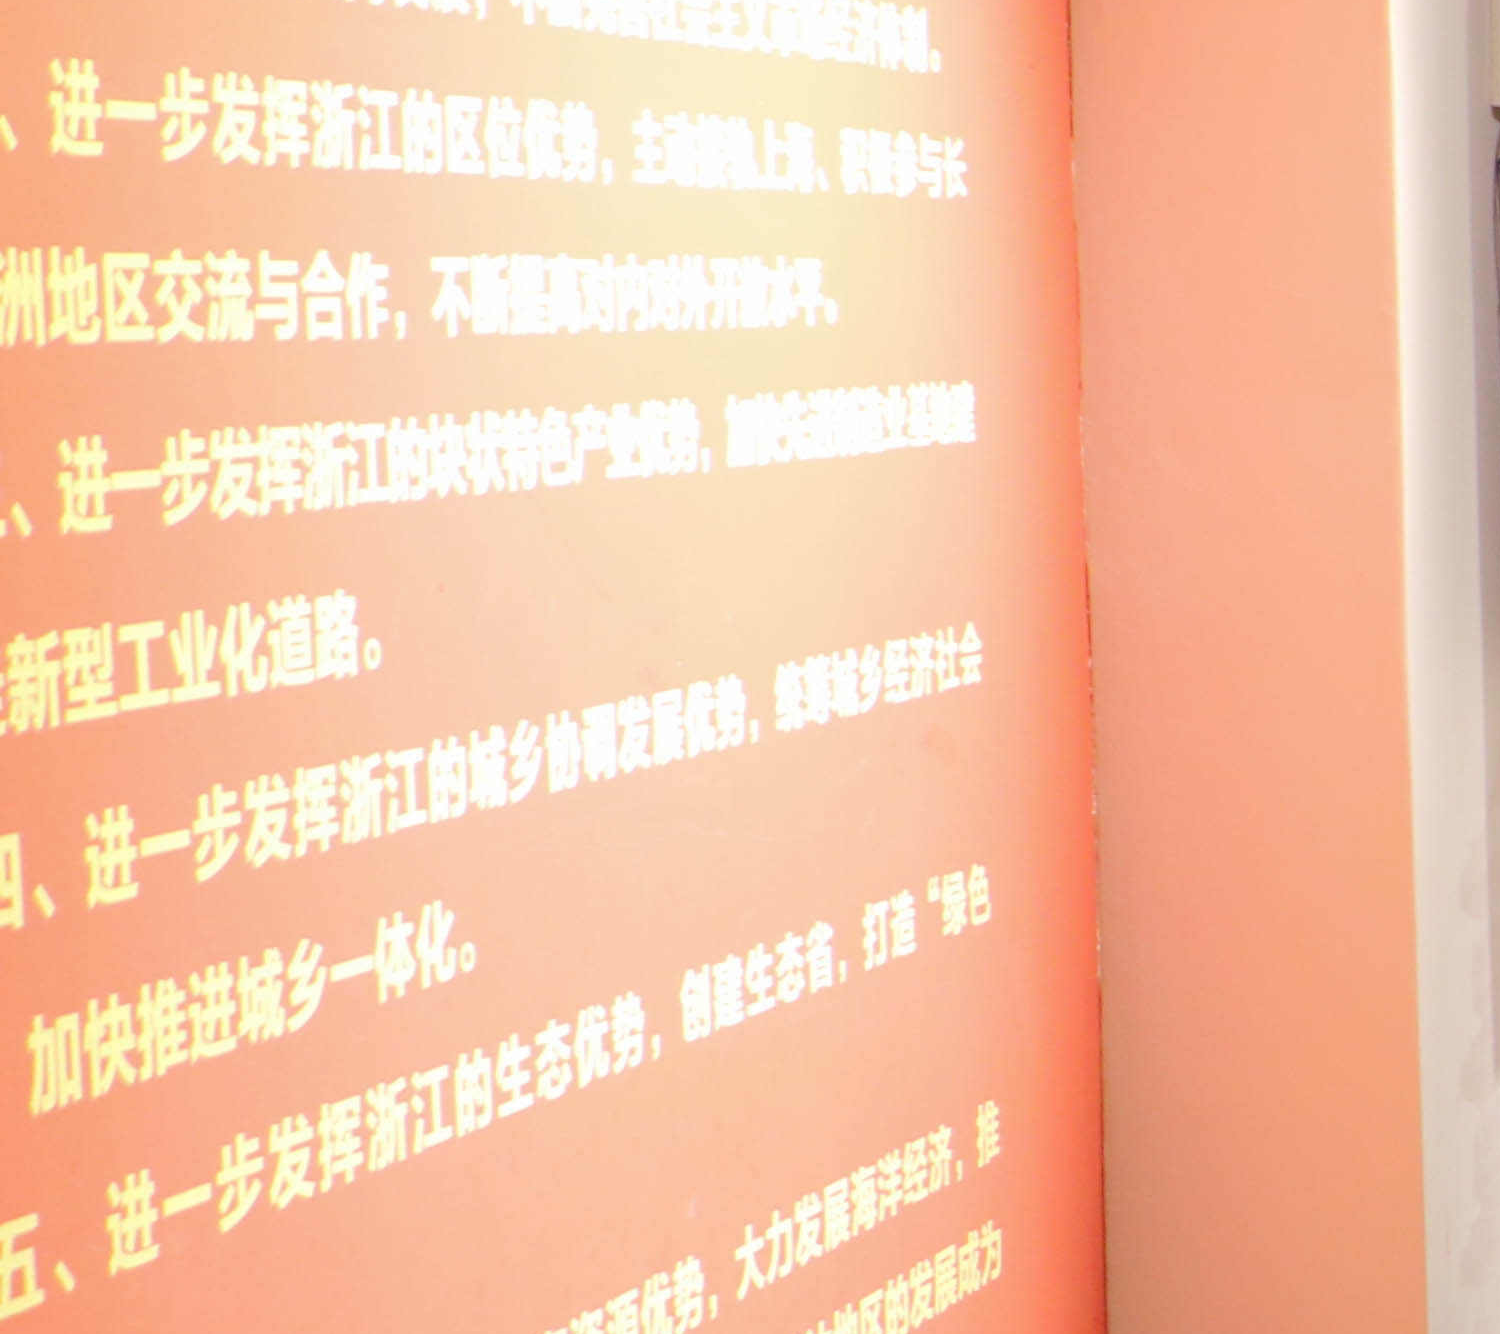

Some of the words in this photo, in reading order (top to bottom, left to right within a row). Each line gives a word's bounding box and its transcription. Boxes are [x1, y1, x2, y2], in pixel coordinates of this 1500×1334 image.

[26, 900, 476, 1116] 加快推进城乡一体化。
